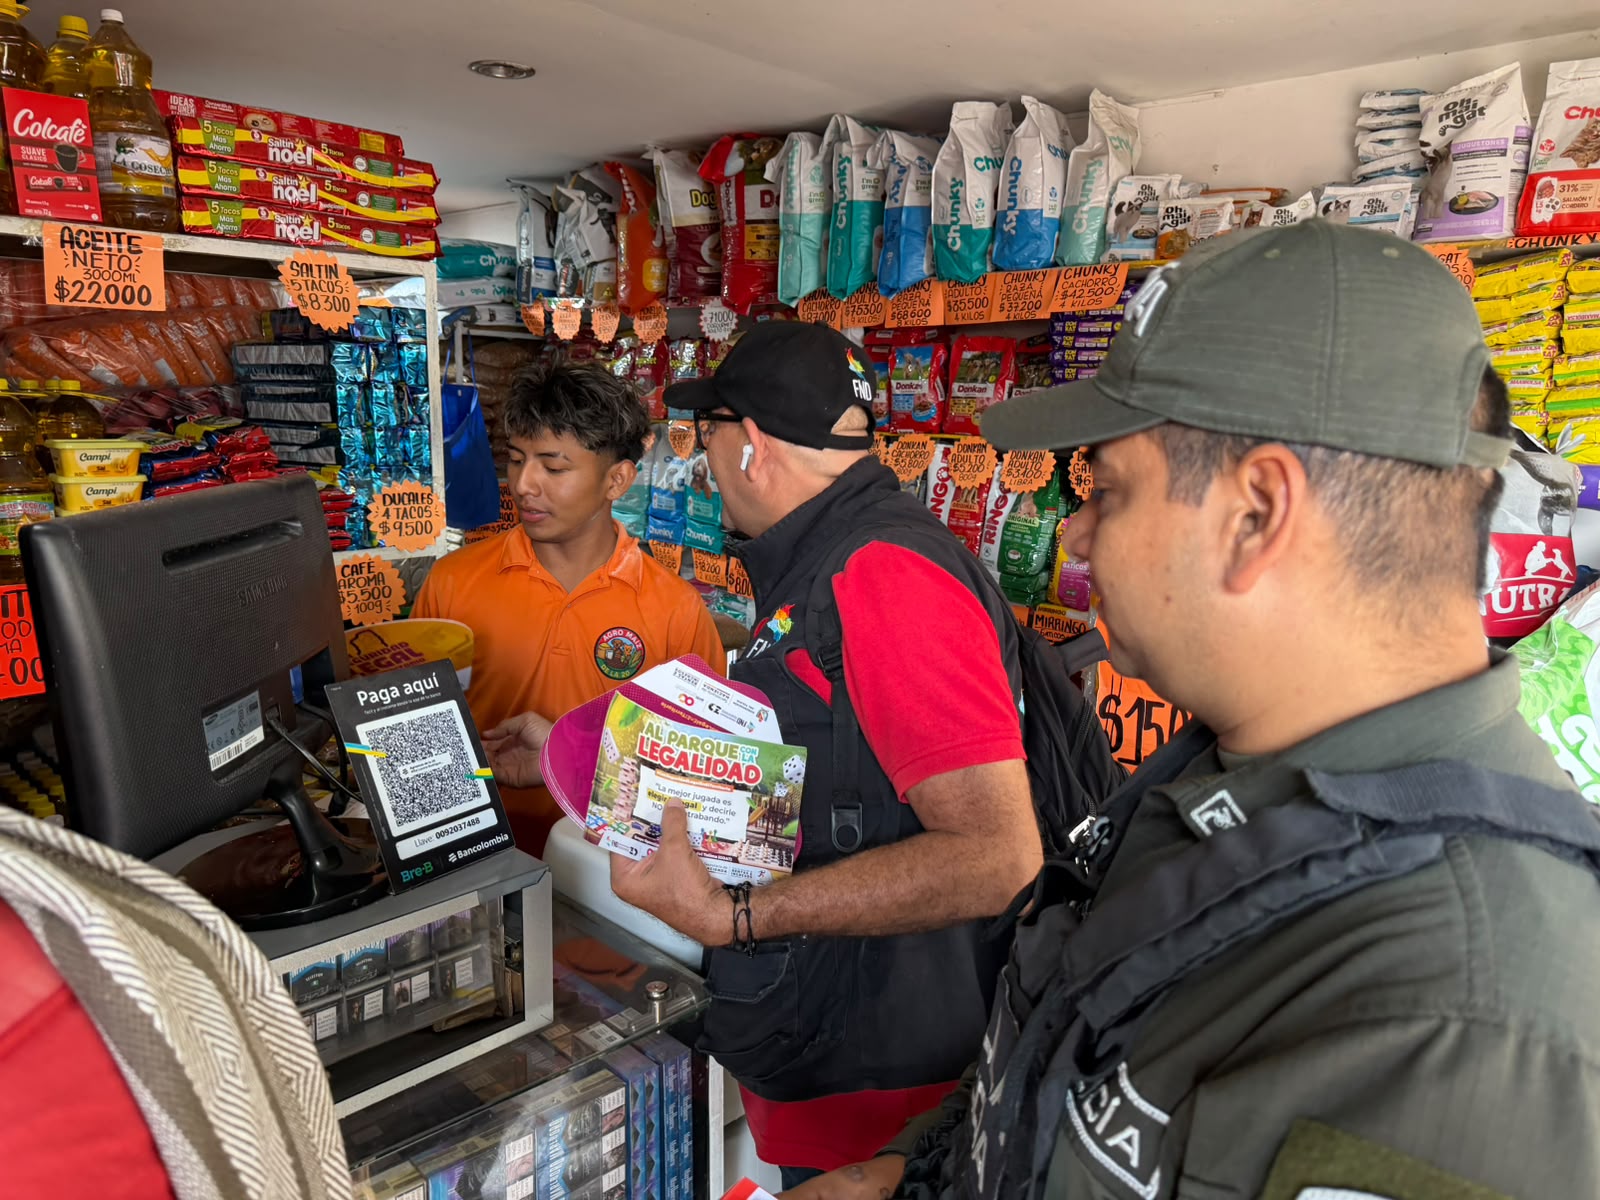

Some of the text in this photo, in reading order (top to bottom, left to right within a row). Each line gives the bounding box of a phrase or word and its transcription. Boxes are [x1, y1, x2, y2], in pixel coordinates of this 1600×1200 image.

[13, 108, 88, 144] Colcafé
[203, 120, 234, 136] 5 Tacos
[209, 142, 232, 153] Ahorro
[268, 138, 294, 149] Saltin
[320, 143, 328, 154] 5
[21, 146, 47, 156] SUAVE
[268, 145, 314, 166] noel
[208, 160, 240, 176] 5 Tacos
[214, 182, 237, 192] Ahorro
[272, 176, 299, 186] Saltin
[324, 179, 332, 191] 5
[272, 183, 318, 204] noel
[1559, 183, 1579, 193] 31%
[1003, 155, 1022, 236] Chunky
[211, 201, 241, 215] 5 Tacos
[946, 176, 964, 252] Chunky
[275, 214, 301, 224] Saltin
[327, 217, 335, 229] 5
[275, 221, 321, 241] noel
[60, 225, 143, 254] ACEITE
[1514, 233, 1598, 249] CHUNKY
[72, 250, 133, 271] NETO
[290, 260, 339, 279] SALTIN
[1063, 263, 1120, 280] CHUNKY
[1003, 270, 1048, 285] CHUNKY
[1061, 276, 1118, 289] CACHORRO
[802, 300, 840, 313] CACHORRO
[1059, 299, 1103, 309] 4 KILOS
[961, 312, 985, 321] KILOS
[1014, 311, 1037, 320] KILOS
[852, 379, 873, 401] FND
[957, 385, 988, 393] Donkan
[897, 441, 928, 450] DONKAN
[957, 443, 988, 453] DONKAN
[79, 452, 111, 463] Campi
[892, 450, 930, 460] CACHORRO
[951, 453, 985, 463] ADULTO
[1009, 450, 1046, 462] DONKAN
[1008, 461, 1042, 471] ADULTO
[85, 486, 118, 497] Campi
[382, 491, 434, 506] DUCALES
[381, 506, 432, 520] 4 TACOS
[1007, 515, 1036, 526] ORIGINAL
[648, 526, 674, 539] Chunky
[685, 528, 715, 546] Chunky
[338, 572, 386, 590] AROMA
[602, 629, 624, 641] AGRO
[356, 684, 400, 706] Paga
[404, 672, 439, 696] aquí
[643, 721, 740, 761] AL PARQUE
[740, 745, 758, 756] CON
[637, 735, 762, 786] LEGALIDAD
[742, 752, 756, 764] LA
[668, 788, 691, 800] mejor
[692, 791, 721, 806] jugada
[709, 804, 737, 817] decirle
[435, 817, 481, 839] 0092037488
[456, 832, 509, 859] Bancolombia
